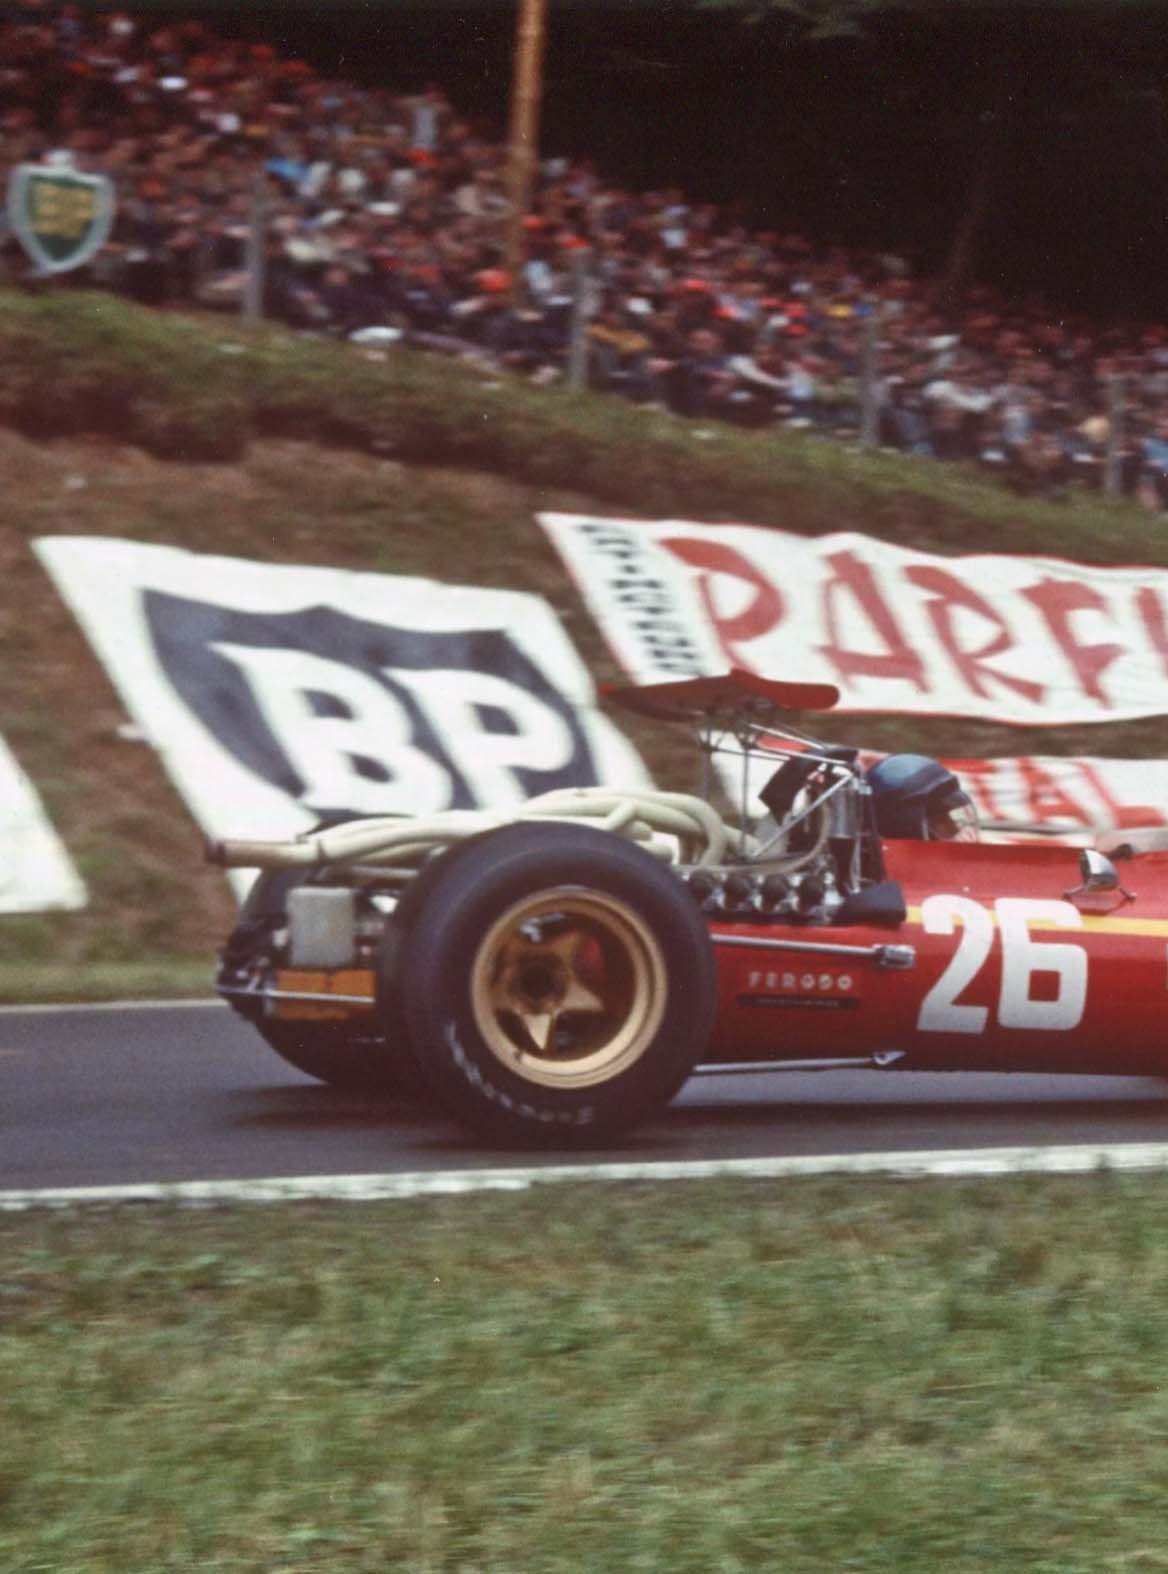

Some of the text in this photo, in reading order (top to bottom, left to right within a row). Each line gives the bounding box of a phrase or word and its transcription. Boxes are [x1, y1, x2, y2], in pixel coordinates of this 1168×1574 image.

[206, 640, 576, 814] BP
[748, 971, 854, 991] FERODO
[916, 894, 1089, 1034] 26
